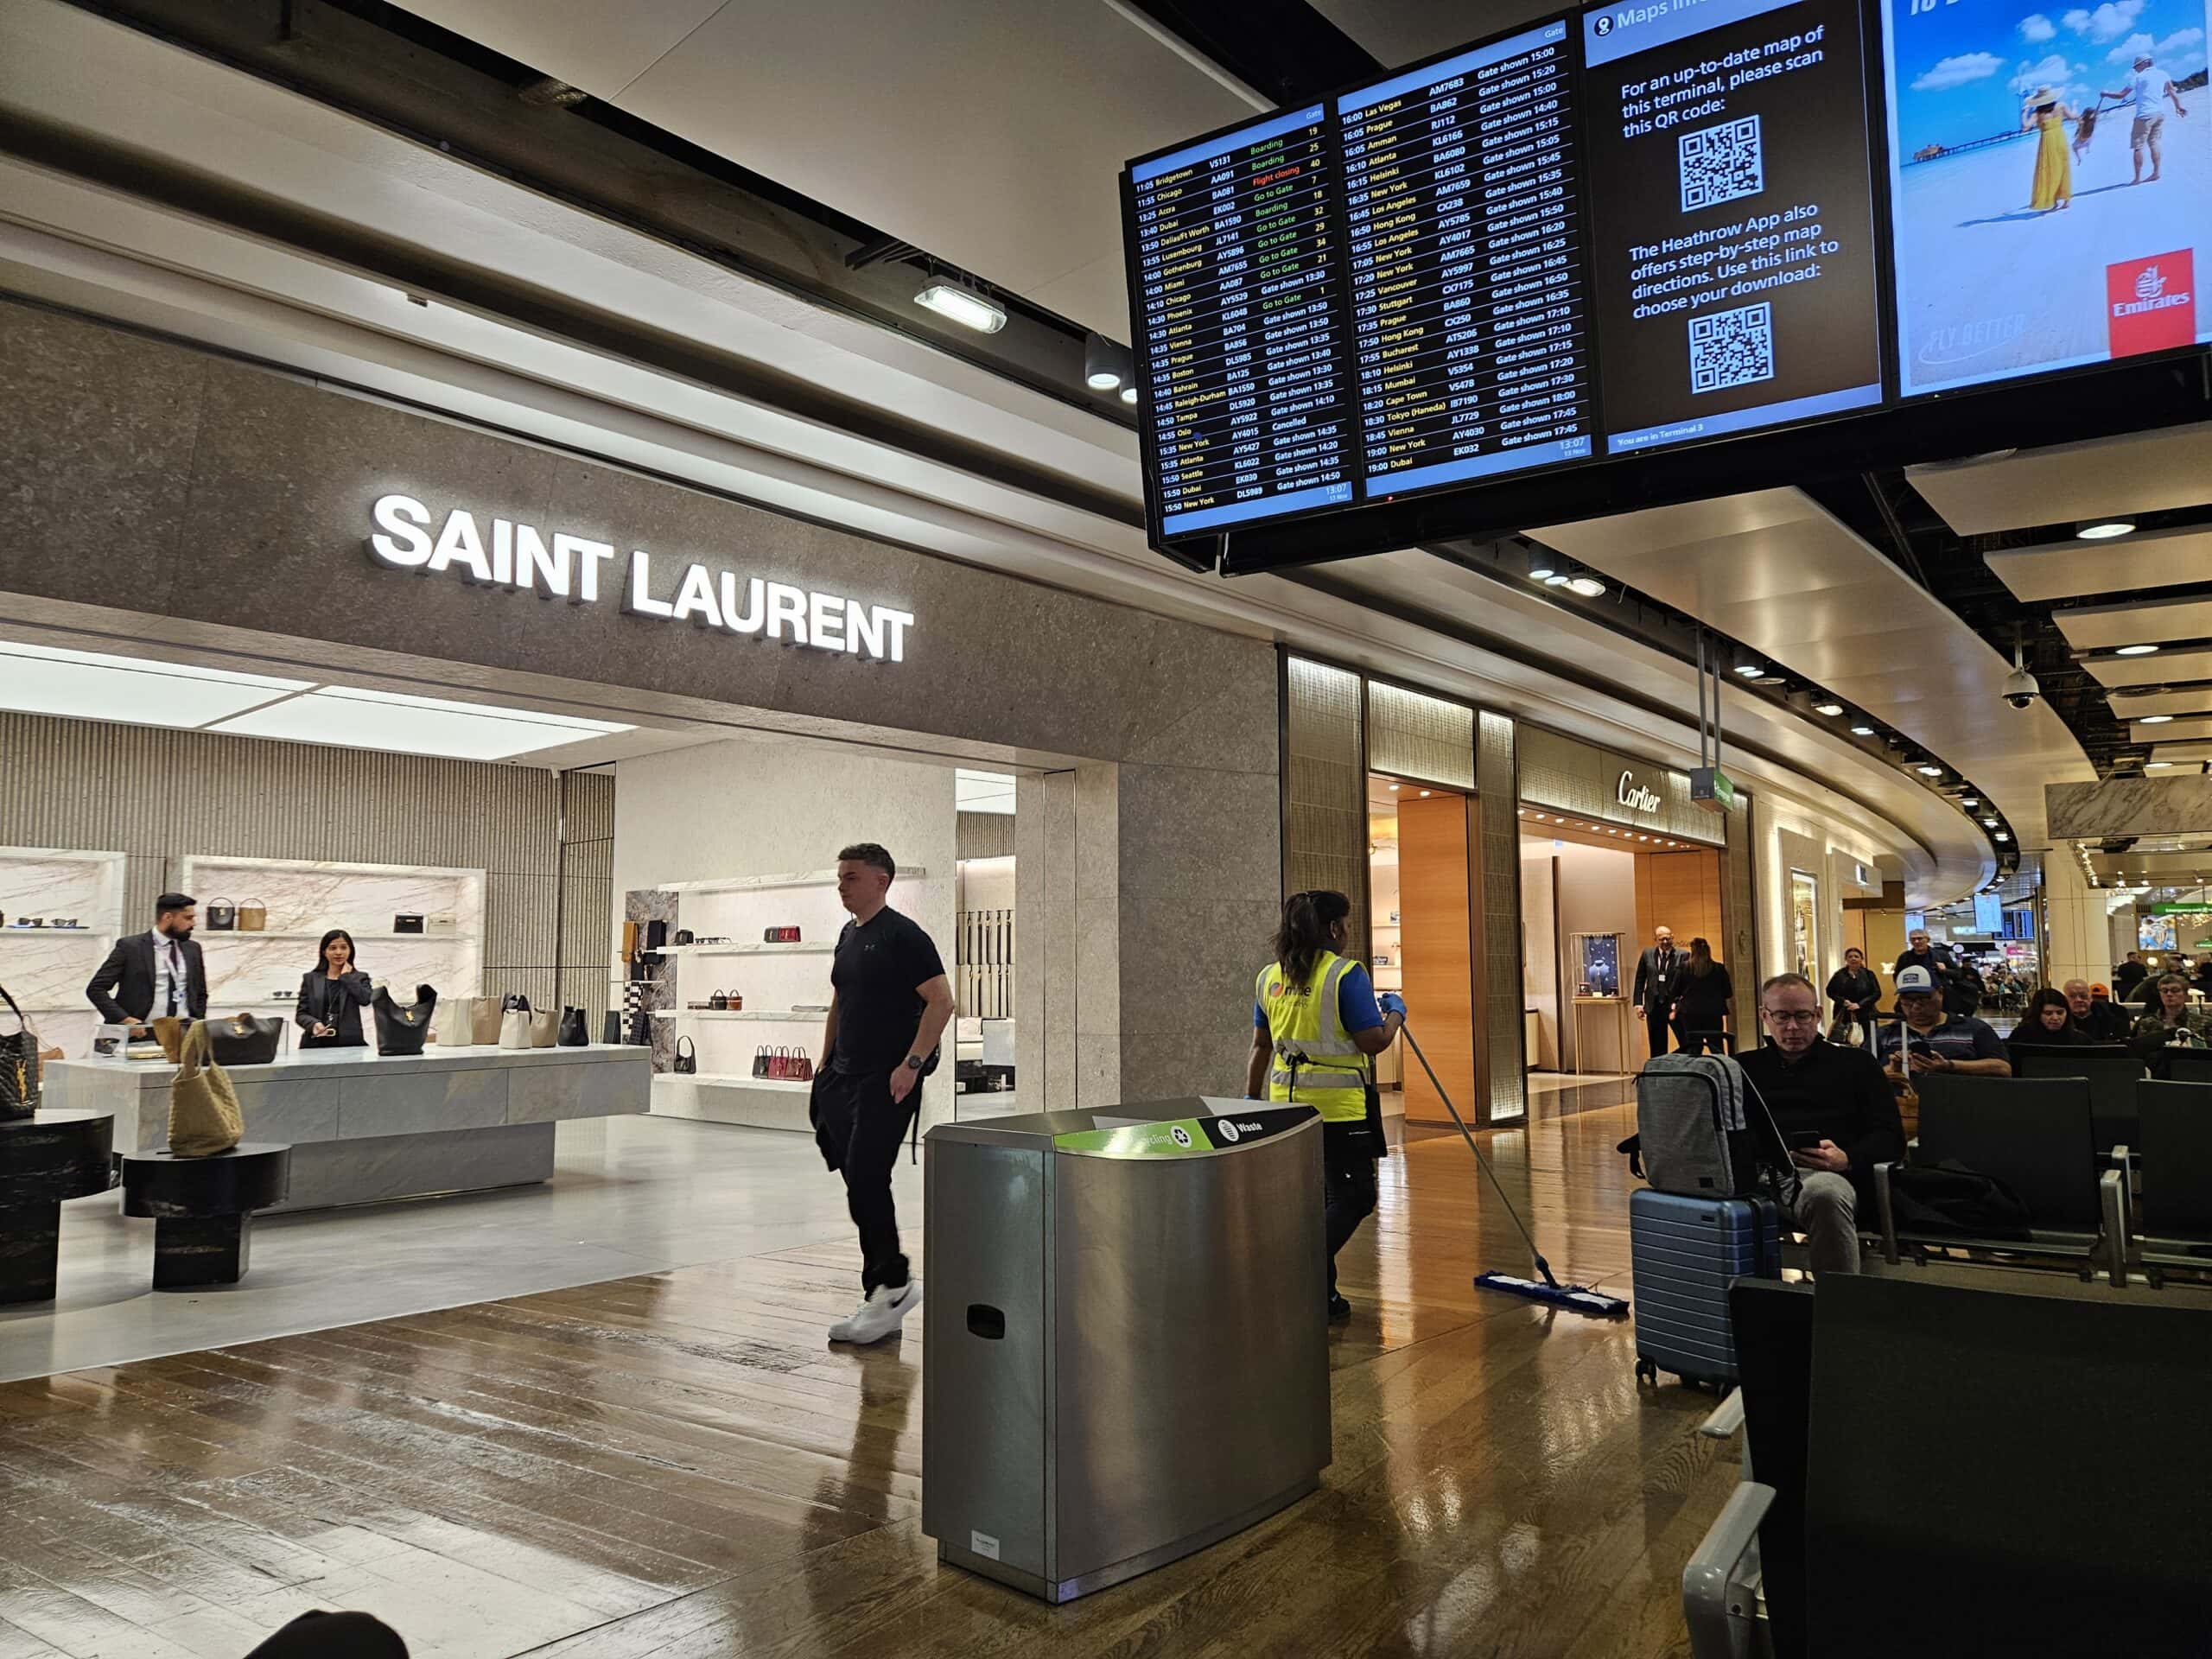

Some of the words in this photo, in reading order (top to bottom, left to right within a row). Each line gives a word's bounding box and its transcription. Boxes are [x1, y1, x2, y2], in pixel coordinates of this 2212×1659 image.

[1544, 27, 1564, 39] Gate
[1617, 2, 1668, 29] Maps
[1342, 111, 1363, 125] 16:00
[1364, 108, 1378, 118] Las
[1378, 99, 1402, 112] Vegas
[1477, 67, 1499, 80] Gate
[1499, 57, 1529, 73] shown
[1530, 47, 1555, 62] 15:00
[1621, 81, 1648, 99] For
[1649, 75, 1670, 91] an
[1673, 48, 1761, 84] up-to-date
[1764, 35, 1802, 56] map
[1804, 24, 1825, 44] of
[1621, 99, 1651, 119] this
[1653, 76, 1726, 109] terminal,
[1729, 61, 1783, 91] please
[1785, 49, 1823, 71] scan
[1306, 108, 1321, 120] Gate
[1343, 127, 1364, 142] 16:05
[1366, 120, 1393, 134] Prague
[1478, 84, 1500, 98] Gate
[1500, 74, 1530, 91] shown
[1531, 64, 1556, 79] 15:20
[1344, 143, 1366, 158] 16:05
[1367, 135, 1397, 150] Amman
[1479, 101, 1502, 114] Gate
[1501, 92, 1531, 108] shown
[1532, 81, 1558, 97] 15:00
[1622, 118, 1653, 138] this
[1654, 110, 1680, 130] QR
[1681, 99, 1726, 121] code:
[1155, 169, 1193, 187] Bridgetown
[1250, 139, 1283, 156] Boarding
[1308, 126, 1318, 136] 19
[1345, 160, 1367, 174] 16:10
[1368, 152, 1397, 167] Atlanta
[1480, 118, 1503, 131] Gate
[1502, 109, 1532, 125] shown
[1533, 99, 1559, 115] 14:40
[1346, 175, 1369, 190] 16:15
[1370, 167, 1400, 182] Helsinki
[1481, 136, 1503, 149] Gate
[1503, 126, 1534, 143] shown
[1535, 116, 1560, 132] 15:15
[1137, 195, 1155, 208] 11:55
[1156, 188, 1183, 201] Chicago
[1251, 155, 1285, 171] Boarding
[1309, 142, 1319, 153] 25
[1139, 210, 1157, 223] 13:25
[1158, 206, 1176, 216] Accra
[1253, 174, 1274, 186] Flight
[1274, 166, 1300, 179] closing
[1310, 158, 1320, 168] 40
[1348, 192, 1370, 207] 16:35
[1370, 188, 1389, 199] New
[1389, 181, 1408, 193] York
[1482, 152, 1505, 166] Gate
[1503, 143, 1535, 159] shown
[1140, 225, 1159, 238] 13:40
[1159, 219, 1179, 232] Dubai
[1275, 185, 1294, 195] Gate
[1312, 175, 1317, 184] 7
[1628, 245, 1660, 262] The
[1662, 223, 1743, 254] Heathrow
[1745, 213, 1782, 233] App
[1783, 204, 1820, 223] also
[1630, 259, 1678, 281] offers
[1679, 233, 1784, 270] step-by-step
[1783, 224, 1823, 243] map
[1631, 271, 1714, 300] directions.
[1717, 262, 1749, 279] Use
[1749, 251, 1785, 271] this
[1783, 243, 1818, 264] link
[1817, 240, 1840, 255] to
[1356, 304, 1377, 318] 17:30
[1378, 296, 1413, 311] Stuttgart
[1490, 270, 1512, 283] Gate
[1511, 263, 1541, 277] shown
[1542, 254, 1567, 269] 16:45
[1632, 296, 1688, 319] choose
[1689, 286, 1729, 309] your
[1730, 262, 1822, 296] download:
[2113, 291, 2191, 318] Emirates
[1150, 343, 1168, 355] 14:35
[1169, 339, 1192, 350] Vienna
[1262, 315, 1282, 326] Gate
[1281, 308, 1306, 321] shown
[1306, 301, 1328, 314] 13:50
[1153, 372, 1171, 385] 14:35
[1172, 368, 1194, 379] Boston
[1265, 346, 1284, 356] Gate
[1284, 339, 1309, 352] shown
[1309, 332, 1331, 345] 13:35
[1154, 387, 1173, 399] 14:40
[1173, 383, 1198, 394] Bahrain
[1267, 361, 1286, 372] Gate
[1285, 354, 1311, 367] shown
[1311, 347, 1332, 360] 13:40
[1193, 437, 1210, 448] York
[1271, 416, 1307, 431] Cancelled
[1365, 430, 1387, 442] 18:45
[1388, 426, 1414, 437] Vienna
[1498, 403, 1521, 414] Gate
[1520, 397, 1550, 410] shown
[1551, 390, 1576, 403] 18:00
[1560, 438, 1585, 450] 13:07
[1659, 424, 1697, 438] Terminal
[1697, 423, 1704, 432] 3
[1368, 461, 1389, 474] 19:00
[1390, 456, 1413, 468] Dubai
[1501, 435, 1523, 447] Gate
[1522, 429, 1553, 442] shown
[1554, 423, 1578, 436] 17:45
[371, 493, 614, 602] SAINT
[630, 550, 914, 663] LAURENT
[1618, 770, 1661, 814] Cartier
[1236, 1121, 1263, 1133] Waste
